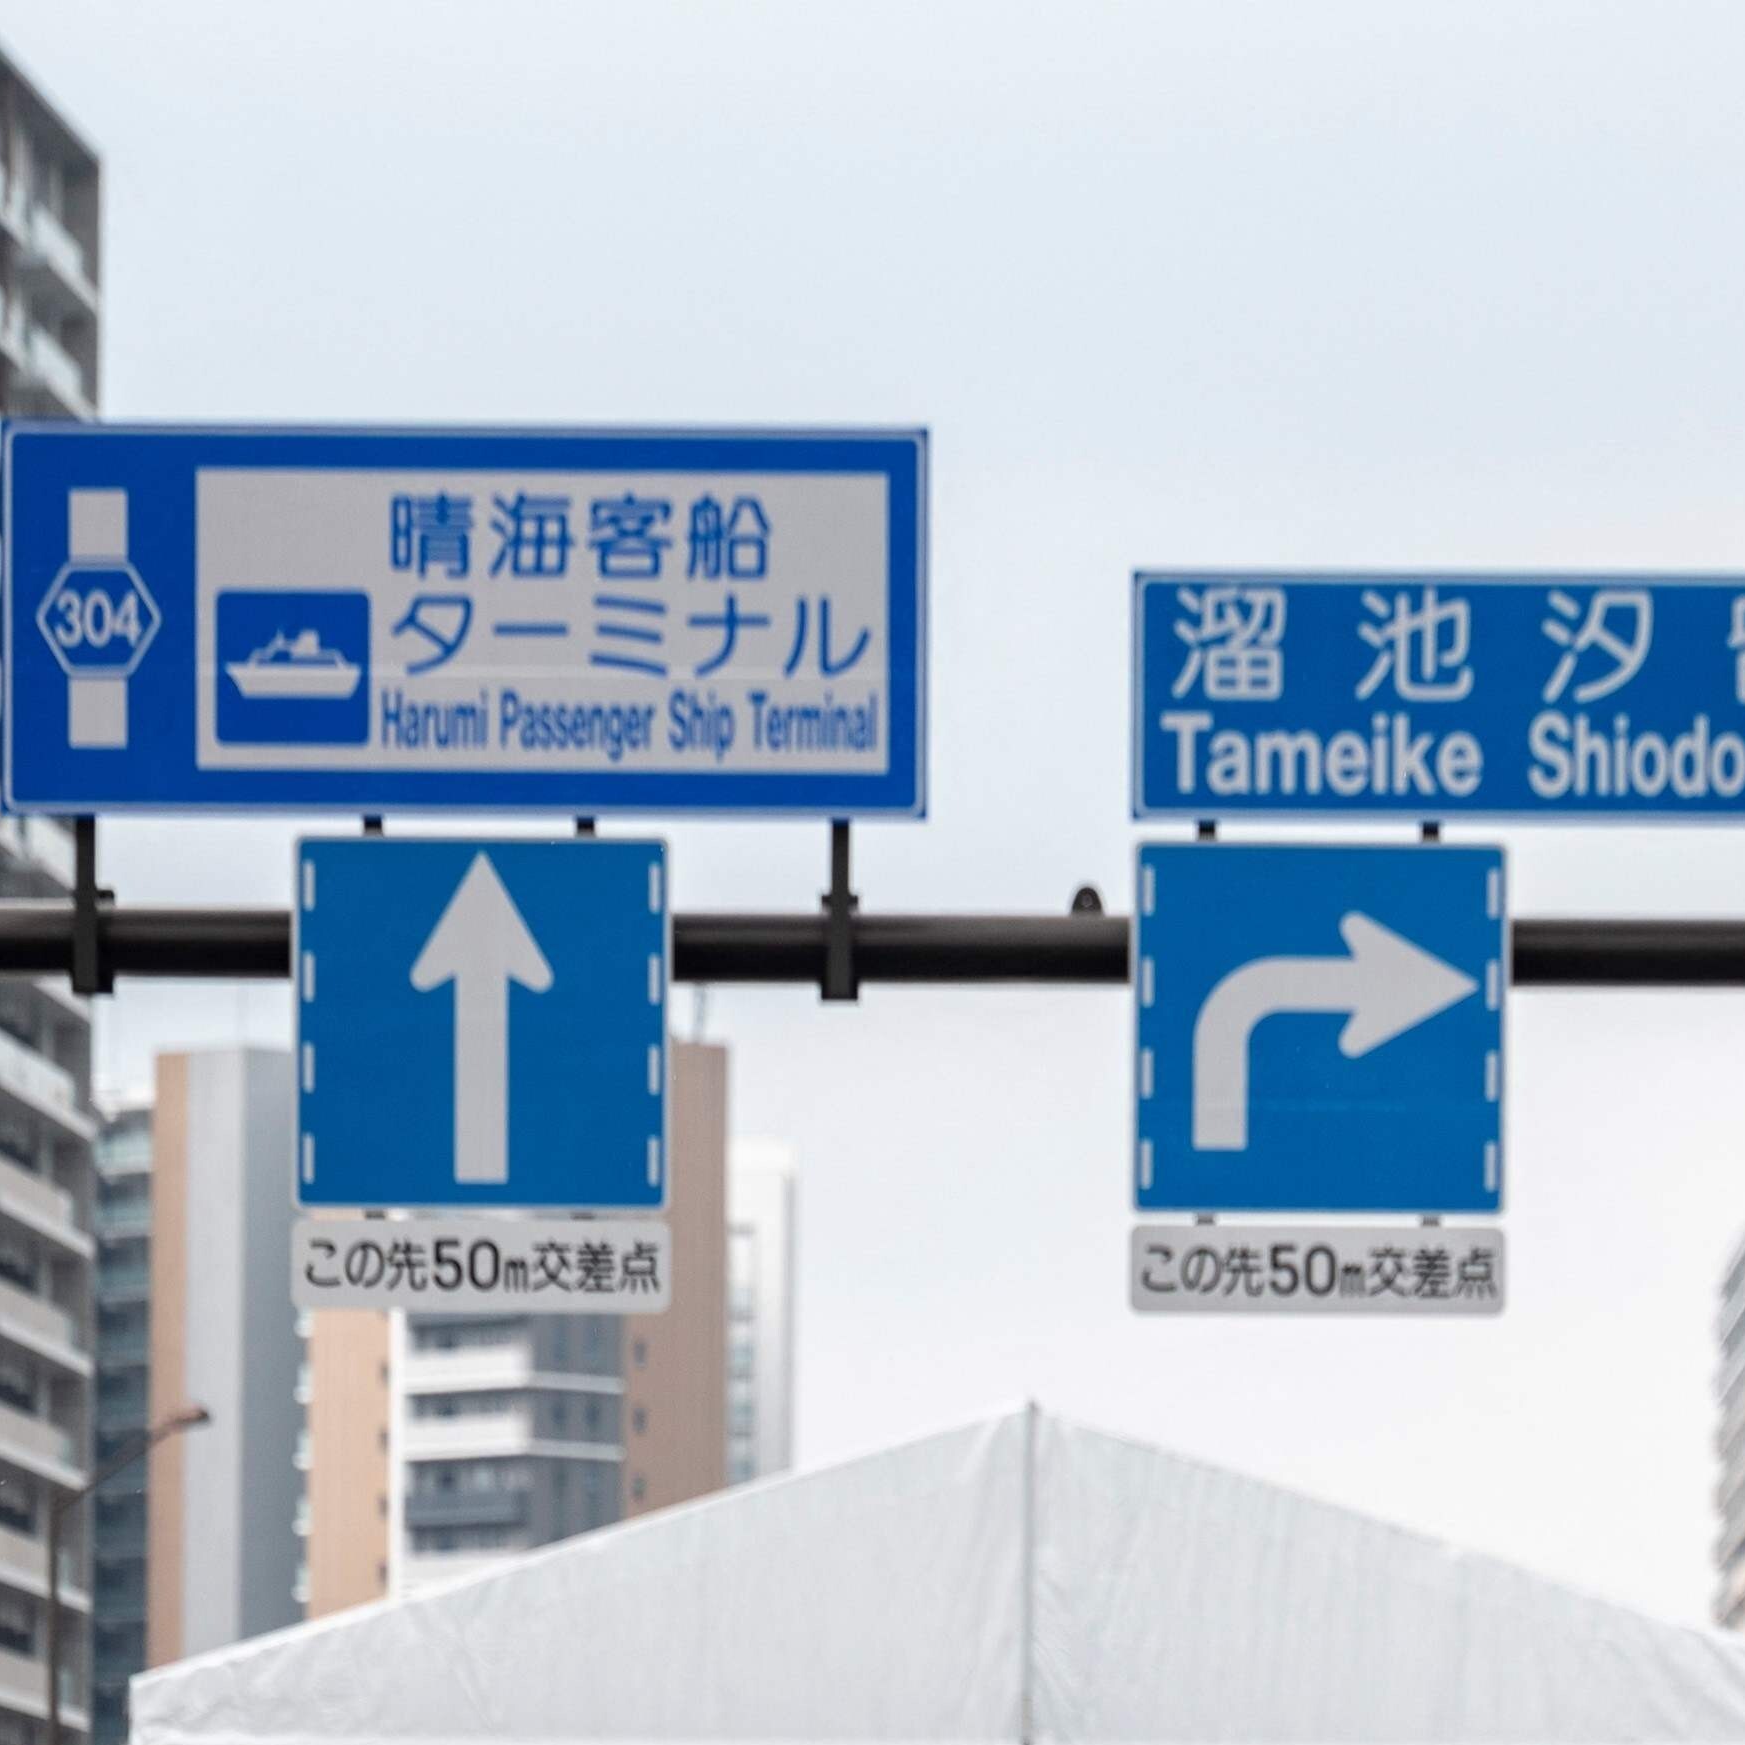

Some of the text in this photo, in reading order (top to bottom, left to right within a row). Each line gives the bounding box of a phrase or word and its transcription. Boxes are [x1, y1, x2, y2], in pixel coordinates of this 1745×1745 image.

[390, 493, 773, 581] 晴海客船
[53, 590, 142, 648] 304
[390, 593, 873, 677] ターミナル
[1170, 587, 1477, 703] 溜池
[380, 691, 878, 764] Harumi Passenger Ship Terminal
[1159, 711, 1485, 799] Tameike
[302, 1239, 662, 1295] この先50m交差点
